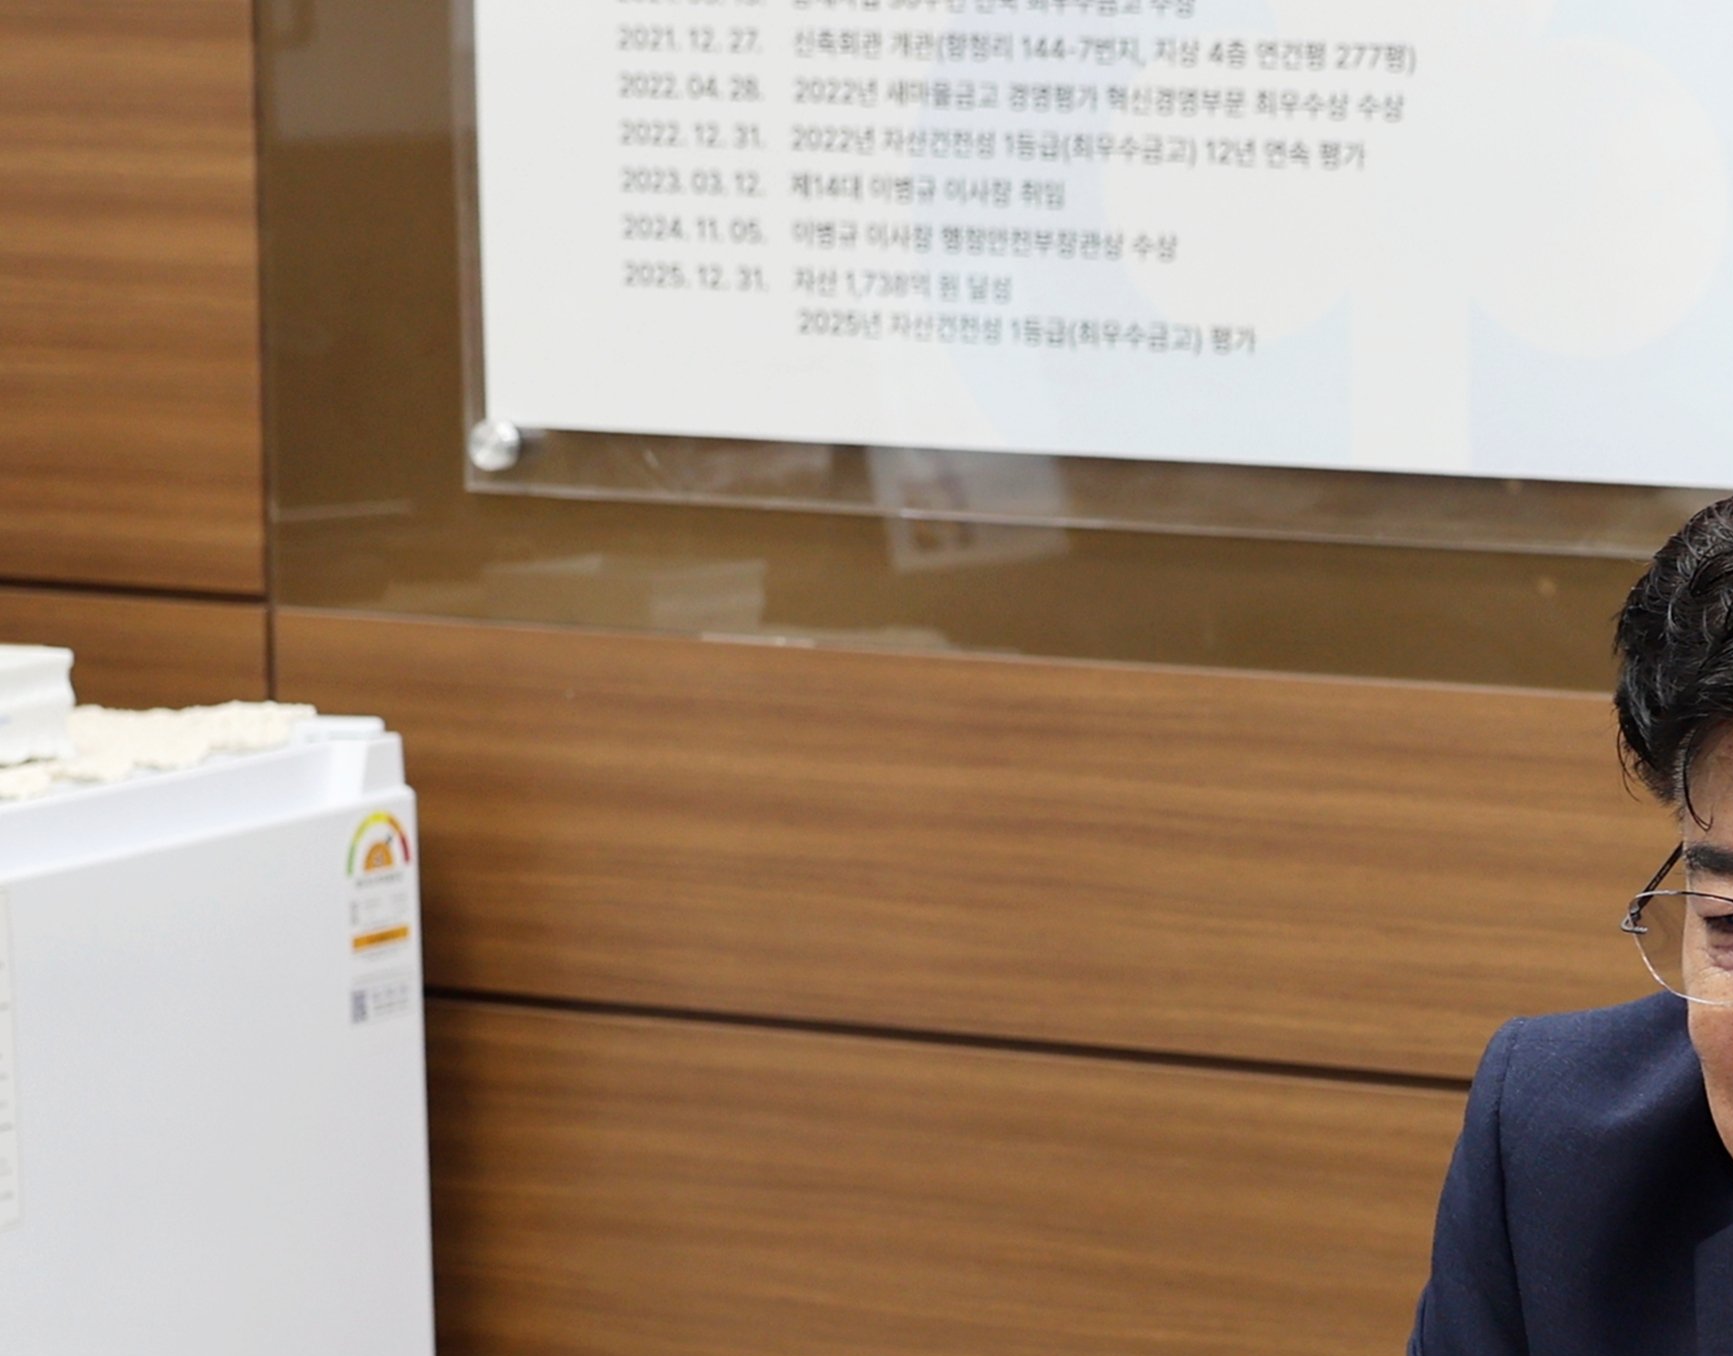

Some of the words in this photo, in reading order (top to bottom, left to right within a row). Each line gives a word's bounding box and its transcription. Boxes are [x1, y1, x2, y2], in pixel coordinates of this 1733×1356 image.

[620, 26, 680, 52] 2021.
[690, 27, 719, 54] 12.
[731, 27, 763, 55] 27.
[796, 29, 883, 60] 신축회관
[1156, 38, 1200, 69] 지상
[1210, 41, 1247, 67] 4층
[1257, 43, 1327, 72] 연건평
[1337, 44, 1417, 75] 277평)
[621, 73, 683, 100] 2022.
[688, 76, 724, 100] 04.
[795, 78, 879, 108] 2022년
[888, 81, 999, 111] 새마을금고
[1010, 85, 1099, 112] 경영평가
[1257, 91, 1350, 122] 최우수상
[1358, 95, 1405, 124] 수상
[622, 120, 684, 148] 2022.
[695, 123, 726, 149] 12.
[735, 124, 765, 150] 31.
[793, 125, 876, 156] 2022년
[885, 129, 997, 160] 자산건전성
[1005, 131, 1198, 167] 1등급(최우수금고)
[1207, 140, 1256, 168] 12년
[1265, 142, 1310, 169] 연속
[1320, 142, 1366, 171] 평가
[623, 168, 687, 195] 2023.
[692, 170, 729, 197] 03.
[735, 172, 766, 198] 12.
[793, 173, 863, 201] 제14대
[872, 177, 937, 203] 이병규
[945, 179, 1013, 209] 이사장
[1022, 181, 1066, 210] 취임
[625, 215, 688, 241] 2024.
[698, 218, 724, 242] 11.
[730, 220, 767, 245] 05.
[794, 223, 858, 247] 이병규
[867, 224, 934, 253] 이사장
[1133, 235, 1179, 264] 수상
[626, 261, 690, 289] 2025.
[699, 265, 728, 291] 12.
[739, 266, 769, 292] 31.
[795, 268, 839, 298] 자산
[940, 275, 960, 303] 원
[968, 276, 1013, 305] 달성
[800, 308, 882, 339] 2025년
[892, 314, 1003, 346] 자산건전성
[1012, 318, 1204, 356] 1등급(최우수금고)
[1212, 327, 1257, 356] 평가
